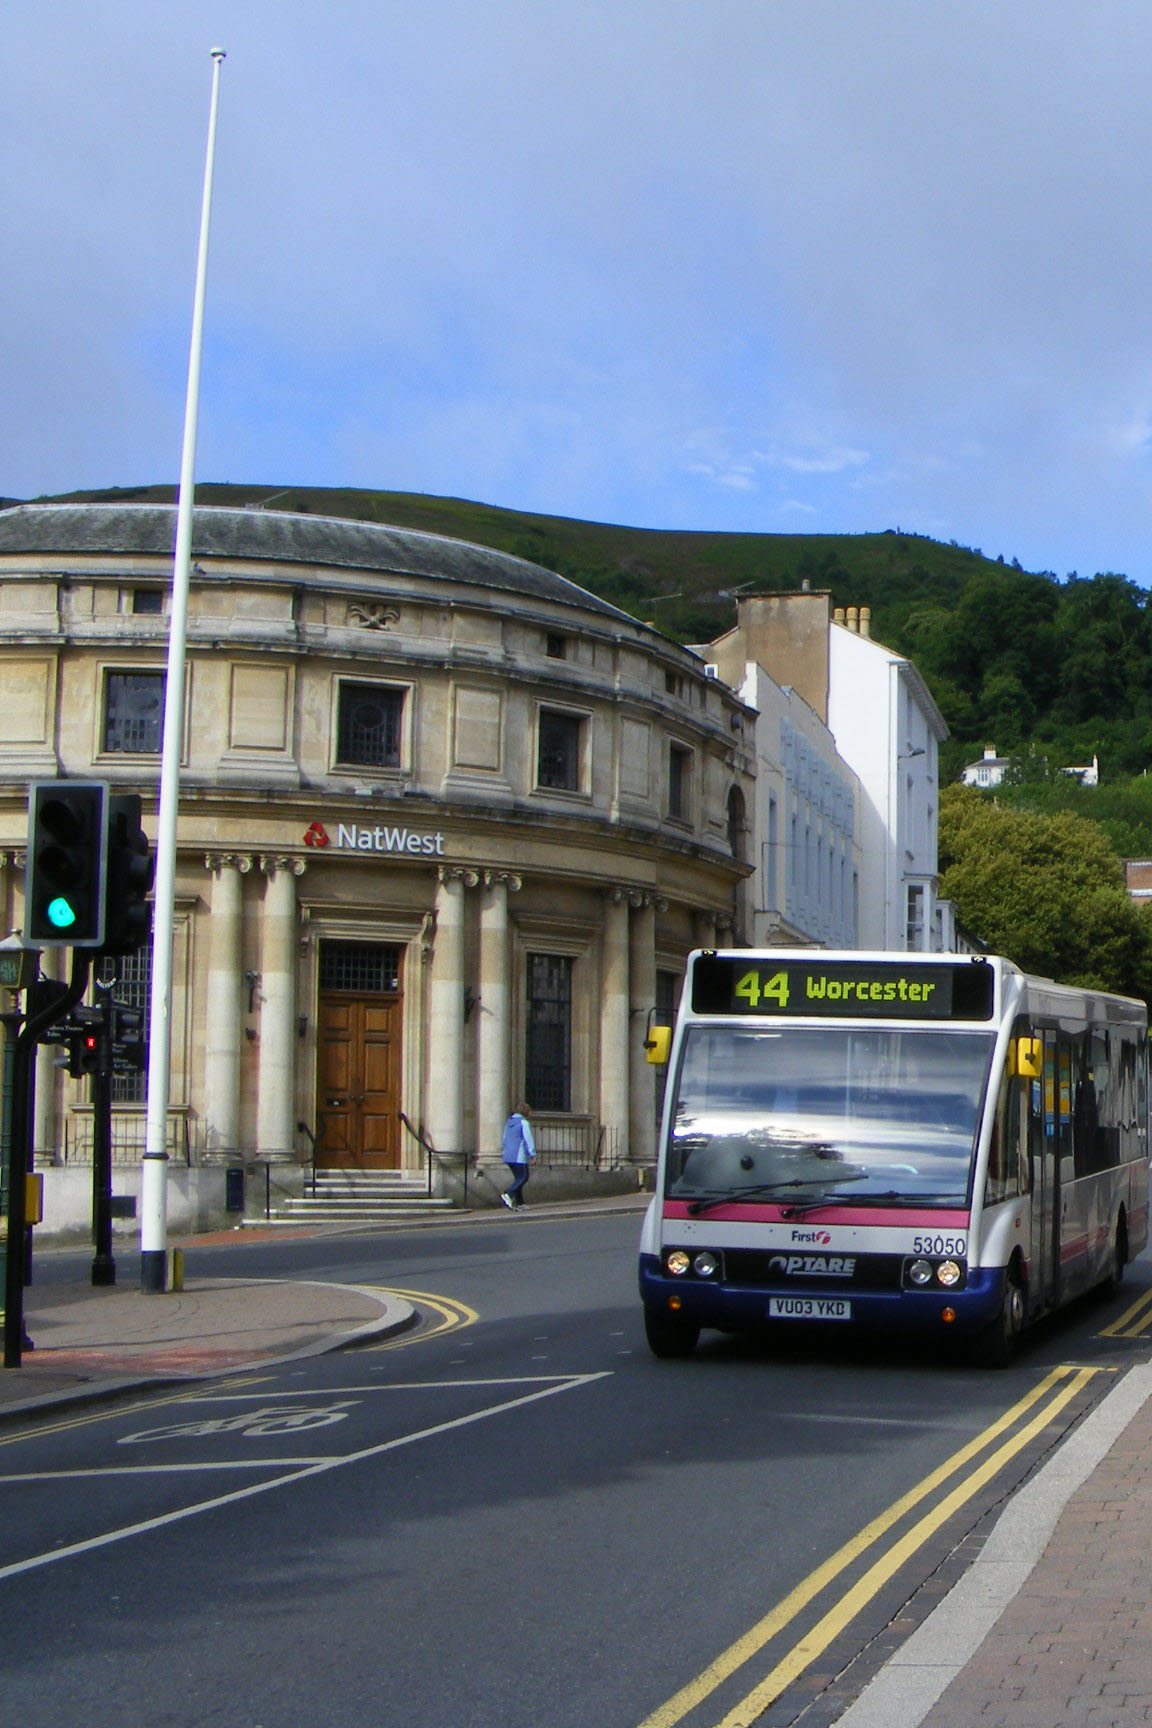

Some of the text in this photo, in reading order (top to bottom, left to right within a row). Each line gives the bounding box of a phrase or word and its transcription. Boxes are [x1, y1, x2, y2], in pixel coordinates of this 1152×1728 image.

[338, 823, 445, 856] NatWest
[735, 969, 935, 1007] 44 Worcester
[791, 1231, 816, 1243] First
[913, 1237, 966, 1256] 53050
[768, 1256, 857, 1275] OPTARE
[776, 1299, 813, 1315] VU03
